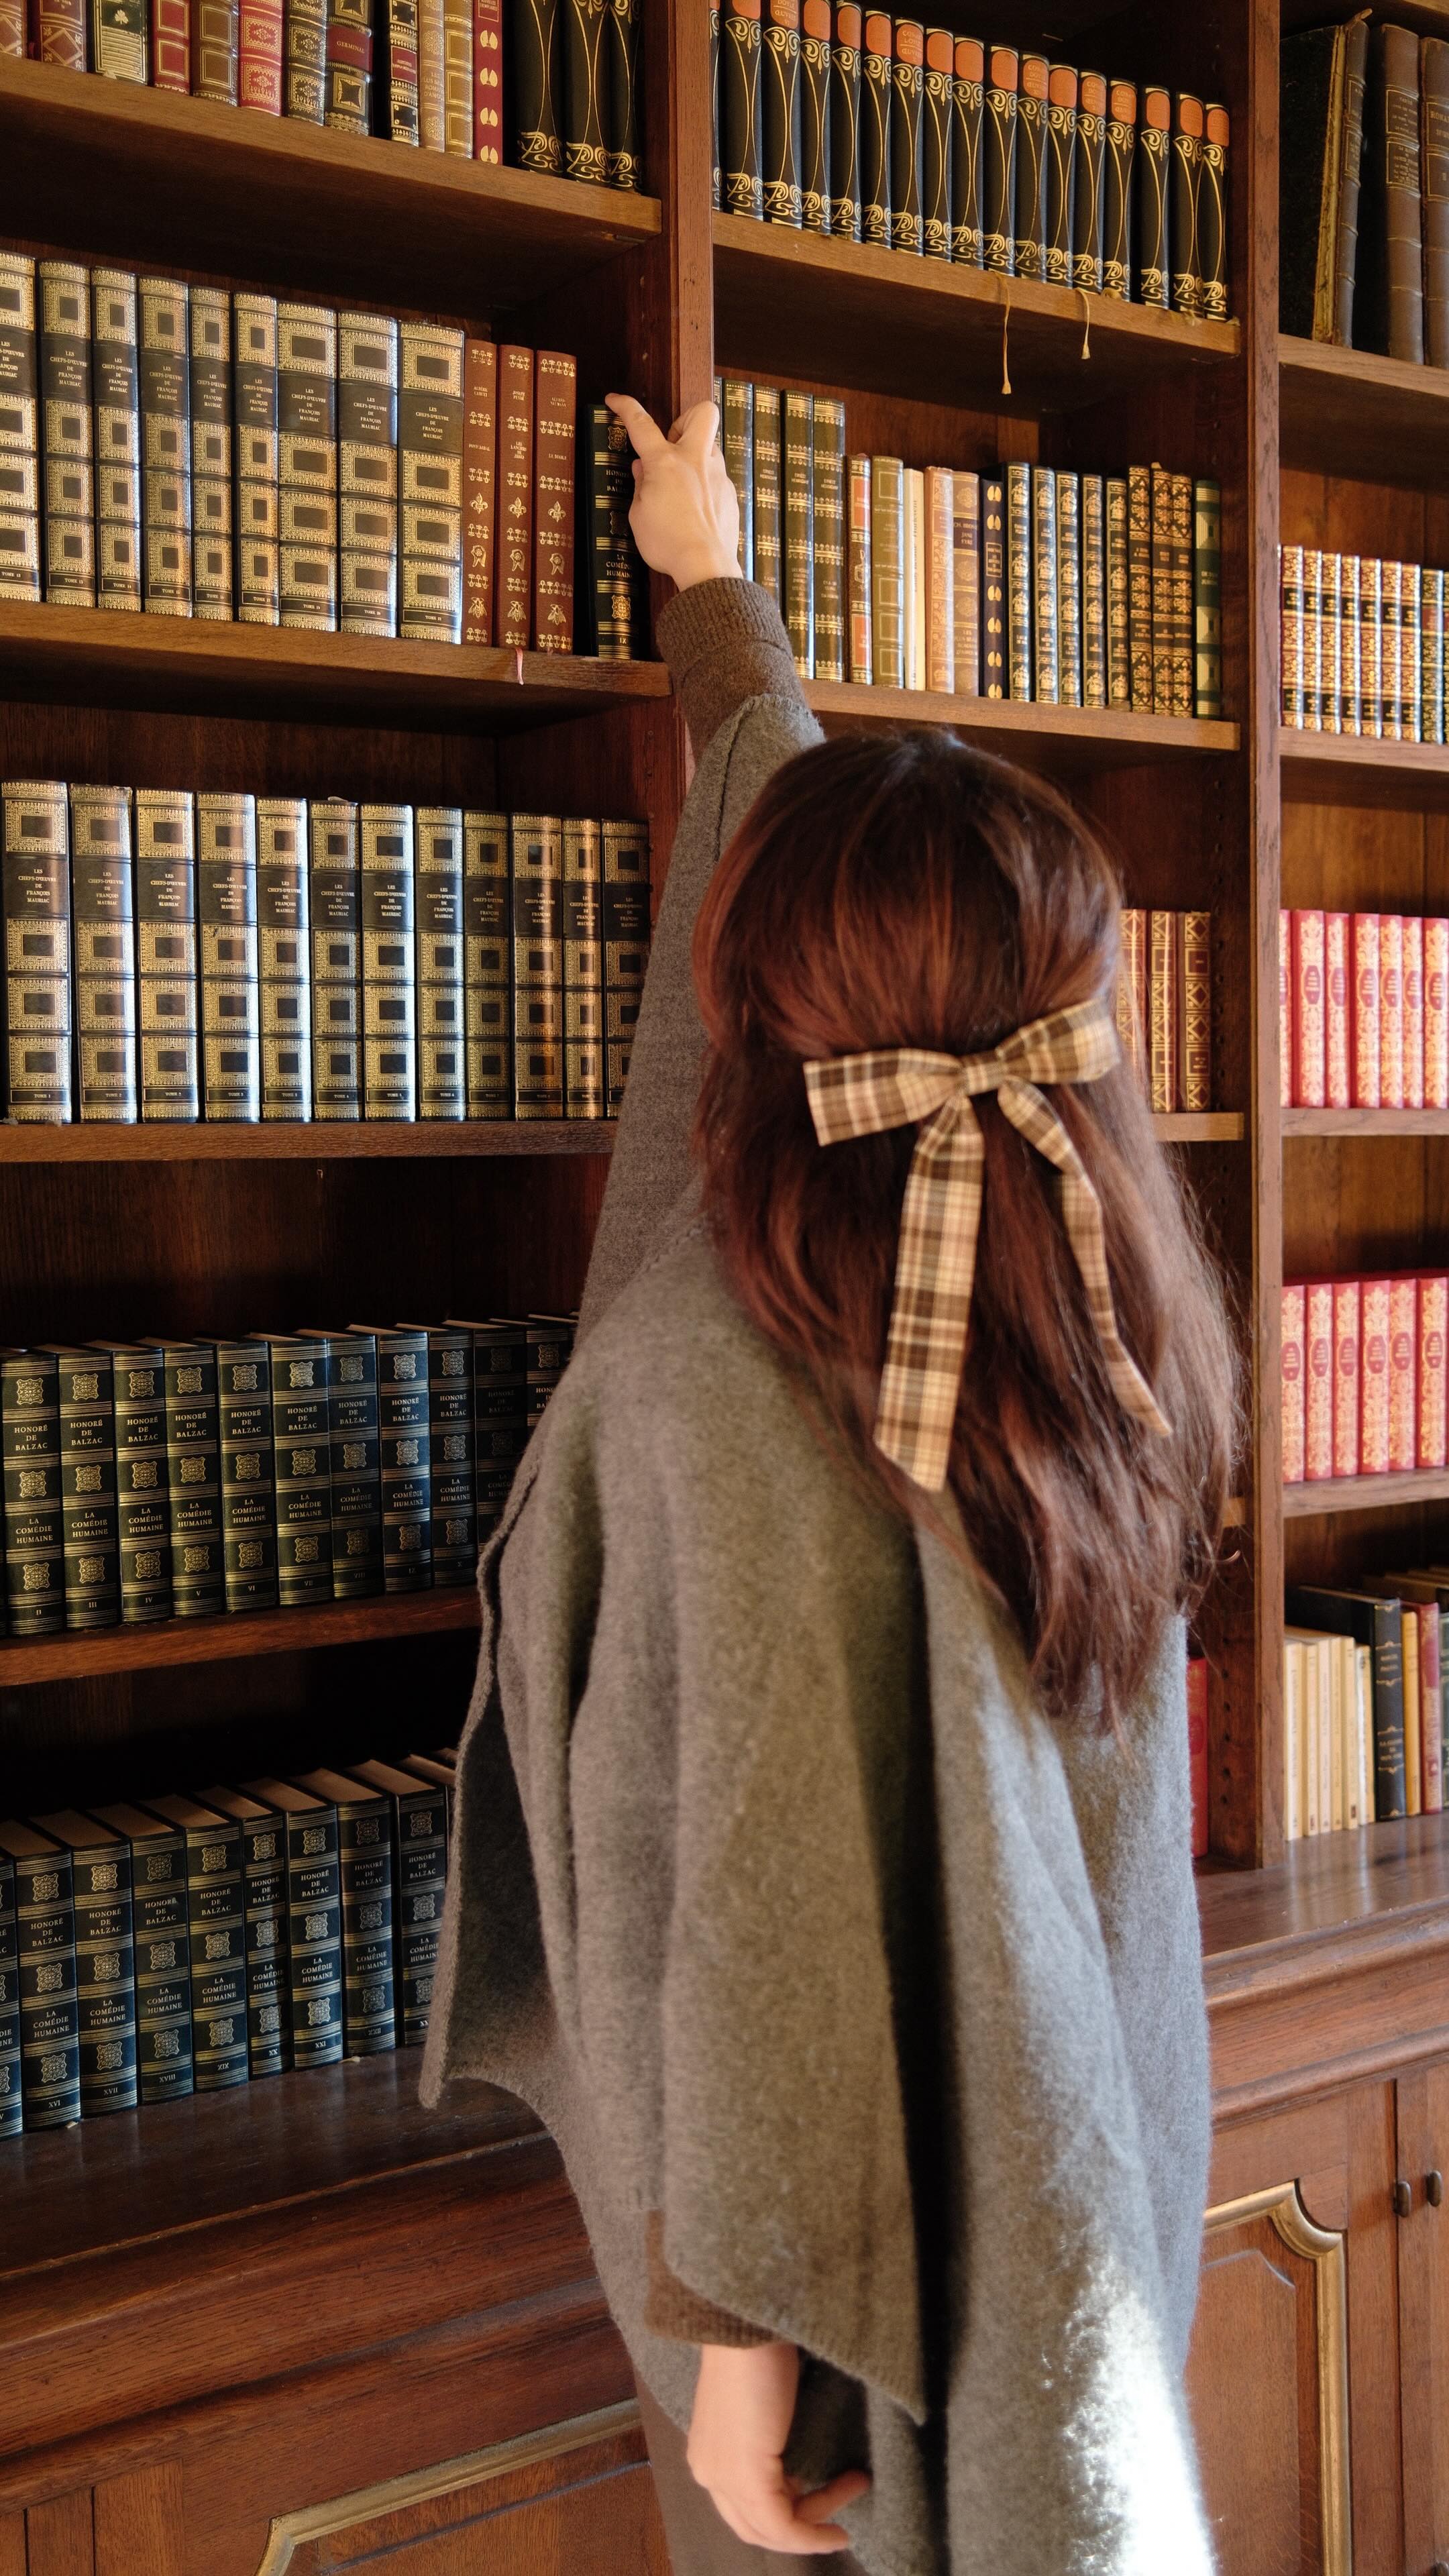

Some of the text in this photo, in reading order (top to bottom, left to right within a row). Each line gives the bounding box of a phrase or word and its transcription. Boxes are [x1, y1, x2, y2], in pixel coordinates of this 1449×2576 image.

[336, 40, 365, 54] GERMINAL
[58, 372, 82, 380] FRANÇOIS
[59, 379, 81, 388] MAURIAC
[299, 408, 321, 416] FRANÇOIS
[360, 416, 381, 424] FRANÇOIS
[423, 425, 443, 433] FRANÇOIS
[339, 1399, 367, 1408] HONORÉ
[392, 1397, 419, 1405] HONORÉ
[231, 1409, 261, 1418] HONORÉ
[287, 1405, 317, 1414] HONORÉ
[175, 1411, 207, 1421] HONORÉ
[339, 1416, 368, 1425] BALZAC
[393, 1413, 419, 1421] BALZAC
[70, 1419, 103, 1428] HONORÉ
[127, 1417, 158, 1425] HONORÉ
[14, 1424, 48, 1433] HONORÉ
[232, 1426, 261, 1434] BALZAC
[288, 1422, 317, 1431] BALZAC
[128, 1434, 158, 1442] BALZAC
[176, 1430, 207, 1438] BALZAC
[71, 1437, 102, 1446] BALZAC
[15, 1442, 47, 1451] BALZAC
[440, 1485, 470, 1493] COMÉDIE
[340, 1494, 370, 1503] COMÉDIE
[392, 1490, 424, 1499] COMÉDIE
[441, 1493, 470, 1501] HUMAINE
[288, 1501, 321, 1509] COMÉDIE
[341, 1503, 372, 1511] HUMAINE
[394, 1499, 423, 1507] HUMAINE
[177, 1509, 211, 1519] COMÉDIE
[232, 1507, 266, 1515] COMÉDIE
[289, 1510, 322, 1519] HUMAINE
[71, 1519, 107, 1528] COMÉDIE
[128, 1515, 163, 1524] COMÉDIE
[178, 1519, 212, 1527] HUMAINE
[233, 1515, 266, 1523] HUMAINE
[15, 1525, 52, 1534] COMÉDIE
[72, 1529, 108, 1538] HUMAINE
[129, 1524, 164, 1534] HUMAINE
[17, 1535, 53, 1544] HUMAINE
[301, 1870, 329, 1881] HONORÉ
[201, 1888, 231, 1899] HONORÉ
[302, 1886, 329, 1897] BALZAC
[145, 1897, 177, 1909] HONORÉ
[89, 1908, 121, 1919] HONORÉ
[201, 1905, 231, 1915] BALZAC
[31, 1917, 63, 1929] HONORÉ
[146, 1915, 176, 1925] BALZAC
[91, 1926, 121, 1935] BALZAC
[32, 1935, 63, 1947] BALZAC
[302, 1962, 332, 1974] COMÉDIE
[303, 1971, 333, 1983] HUMAINE
[202, 1983, 235, 1994] COMÉDIE
[147, 1994, 181, 2004] COMÉDIE
[203, 1992, 236, 2003] HUMAINE
[90, 2005, 125, 2017] COMÉDIE
[148, 2002, 182, 2014] HUMAINE
[34, 2016, 68, 2029] COMÉDIE
[91, 2014, 126, 2025] HUMAINE
[34, 2025, 70, 2038] HUMAINE
